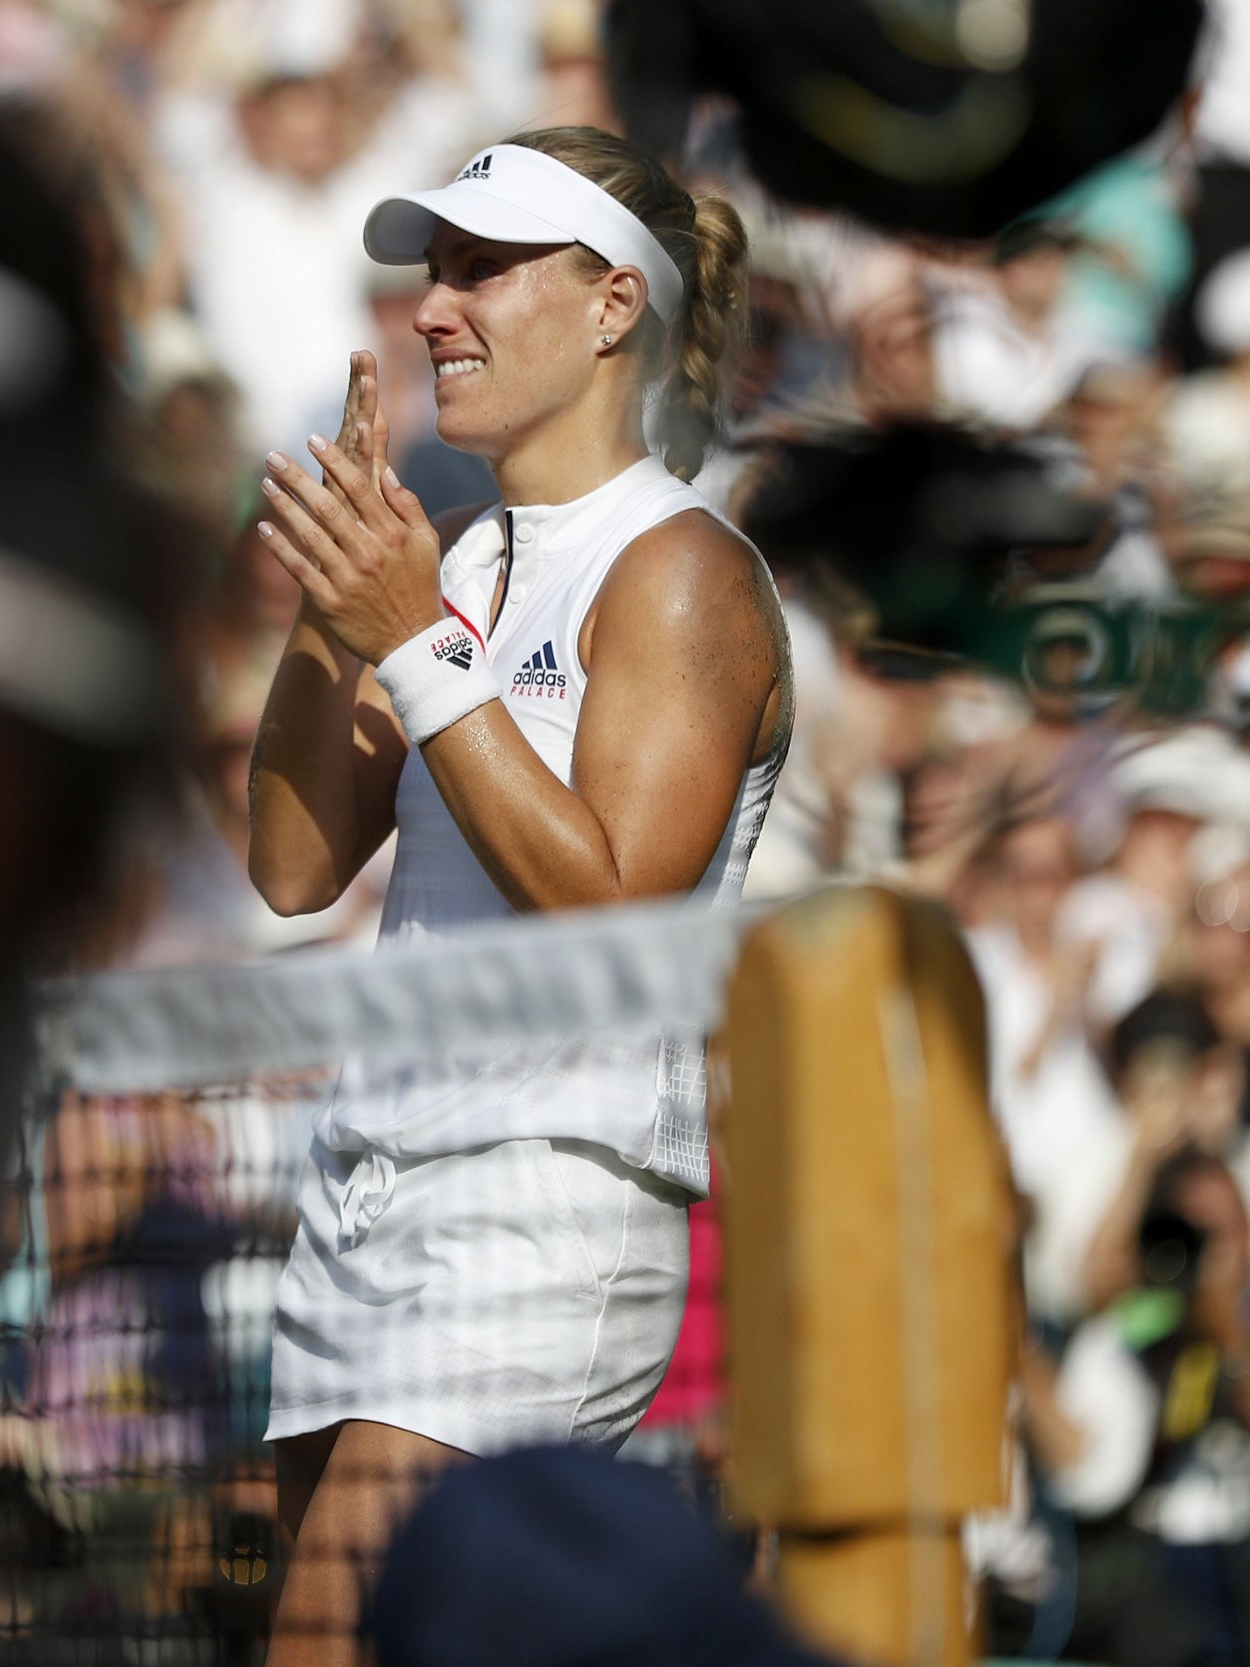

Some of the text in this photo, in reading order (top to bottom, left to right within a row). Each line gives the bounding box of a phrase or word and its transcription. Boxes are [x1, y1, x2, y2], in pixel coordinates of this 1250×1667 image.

[434, 637, 472, 660] adidas
[513, 668, 566, 687] adidas
[510, 686, 566, 700] PALACE
